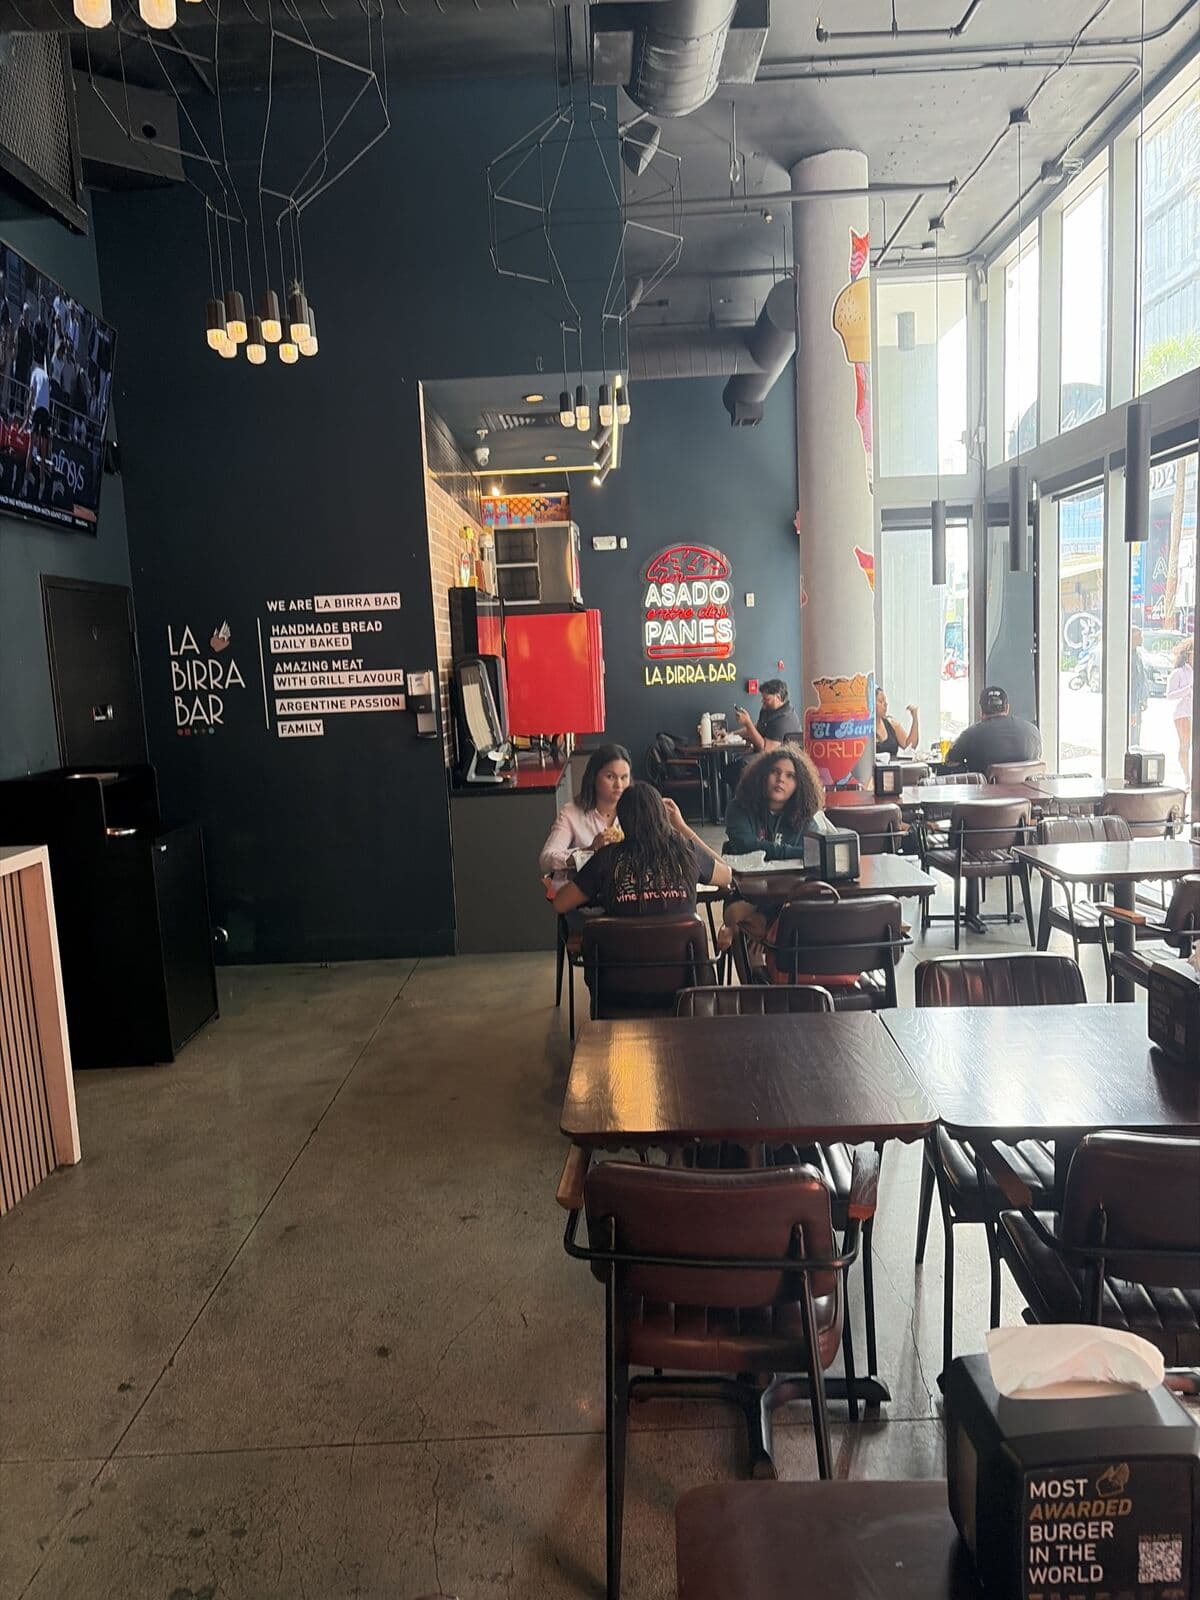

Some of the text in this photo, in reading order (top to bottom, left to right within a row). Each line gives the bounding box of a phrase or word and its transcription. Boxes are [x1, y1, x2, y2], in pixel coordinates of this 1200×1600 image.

[267, 595, 398, 612] WE ARE LA BIRRA BAR
[645, 581, 730, 607] ASADO
[271, 620, 383, 636] HANDMADE BREAD
[645, 619, 733, 646] PANES
[168, 625, 200, 656] LA
[273, 637, 349, 650] DAILY BAKED
[171, 659, 246, 692] BIRRA
[275, 659, 363, 673] AMAZING MEAT
[645, 662, 737, 685] LA BIRRA BAR
[276, 672, 401, 687] WITH GRILL FLAVOUR
[175, 695, 224, 726] BAR
[279, 697, 400, 712] ARGENTINE PASSION
[280, 723, 321, 735] FAMILY
[812, 723, 830, 739] El
[1030, 1479, 1088, 1498] MOST
[1029, 1499, 1132, 1520] AWARDED
[1030, 1521, 1114, 1542] BURGER
[1029, 1544, 1097, 1564] IN THE
[1029, 1565, 1104, 1585] WORLD
